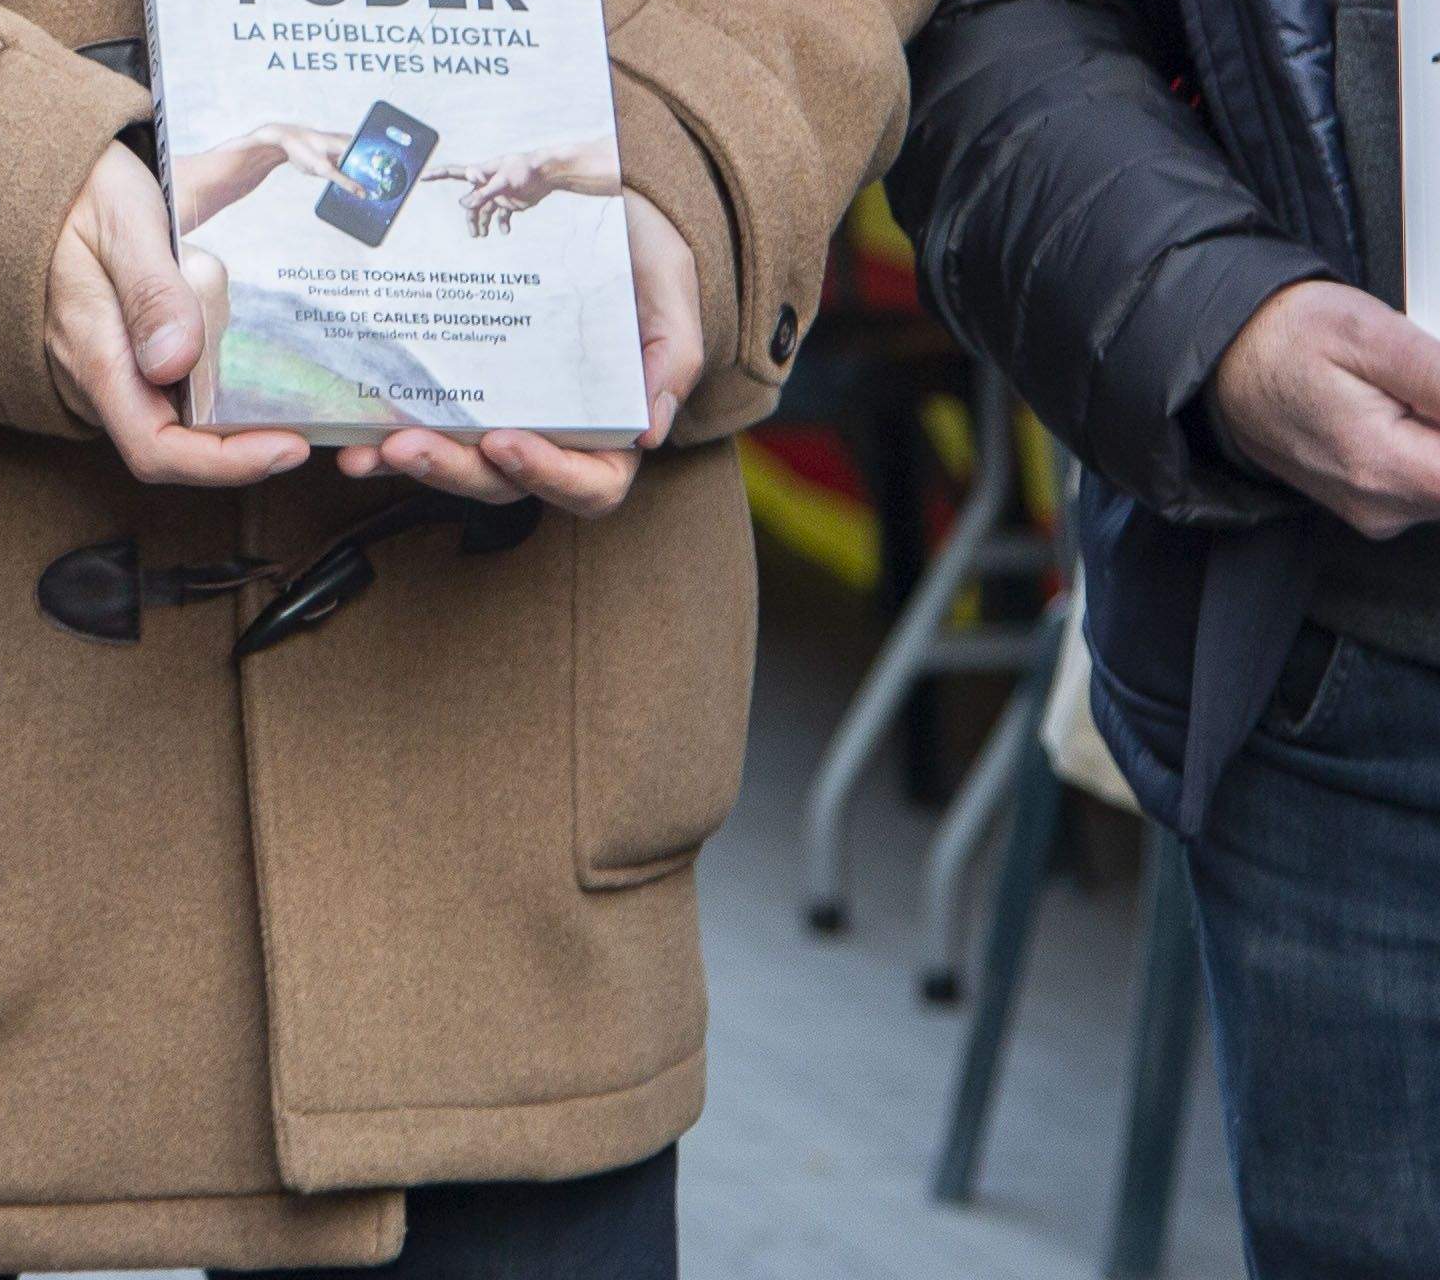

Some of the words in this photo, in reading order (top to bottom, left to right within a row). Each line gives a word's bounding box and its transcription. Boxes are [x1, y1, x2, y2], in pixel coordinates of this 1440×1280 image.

[232, 21, 266, 43] LA
[272, 17, 425, 45] REPÚBLICA
[431, 26, 541, 49] DIGITAL
[267, 51, 286, 70] A
[291, 51, 339, 72] LES
[344, 52, 425, 74] TEVES
[432, 55, 511, 76] MANS
[278, 267, 337, 282] PRÒLEG
[340, 269, 360, 281] DE
[363, 270, 426, 284] TOOMAS
[429, 272, 496, 285] HENDRIK
[500, 273, 541, 286] ILVES
[308, 285, 371, 298] President
[435, 287, 515, 303] (2006-2016)
[350, 311, 368, 323] DE
[373, 312, 430, 325] CARLES
[433, 313, 532, 327] PUIGDEMONT
[357, 328, 419, 343] president
[422, 330, 438, 341] de
[441, 331, 507, 345] Catalunya
[357, 383, 380, 399] La
[388, 384, 485, 406] Campana
